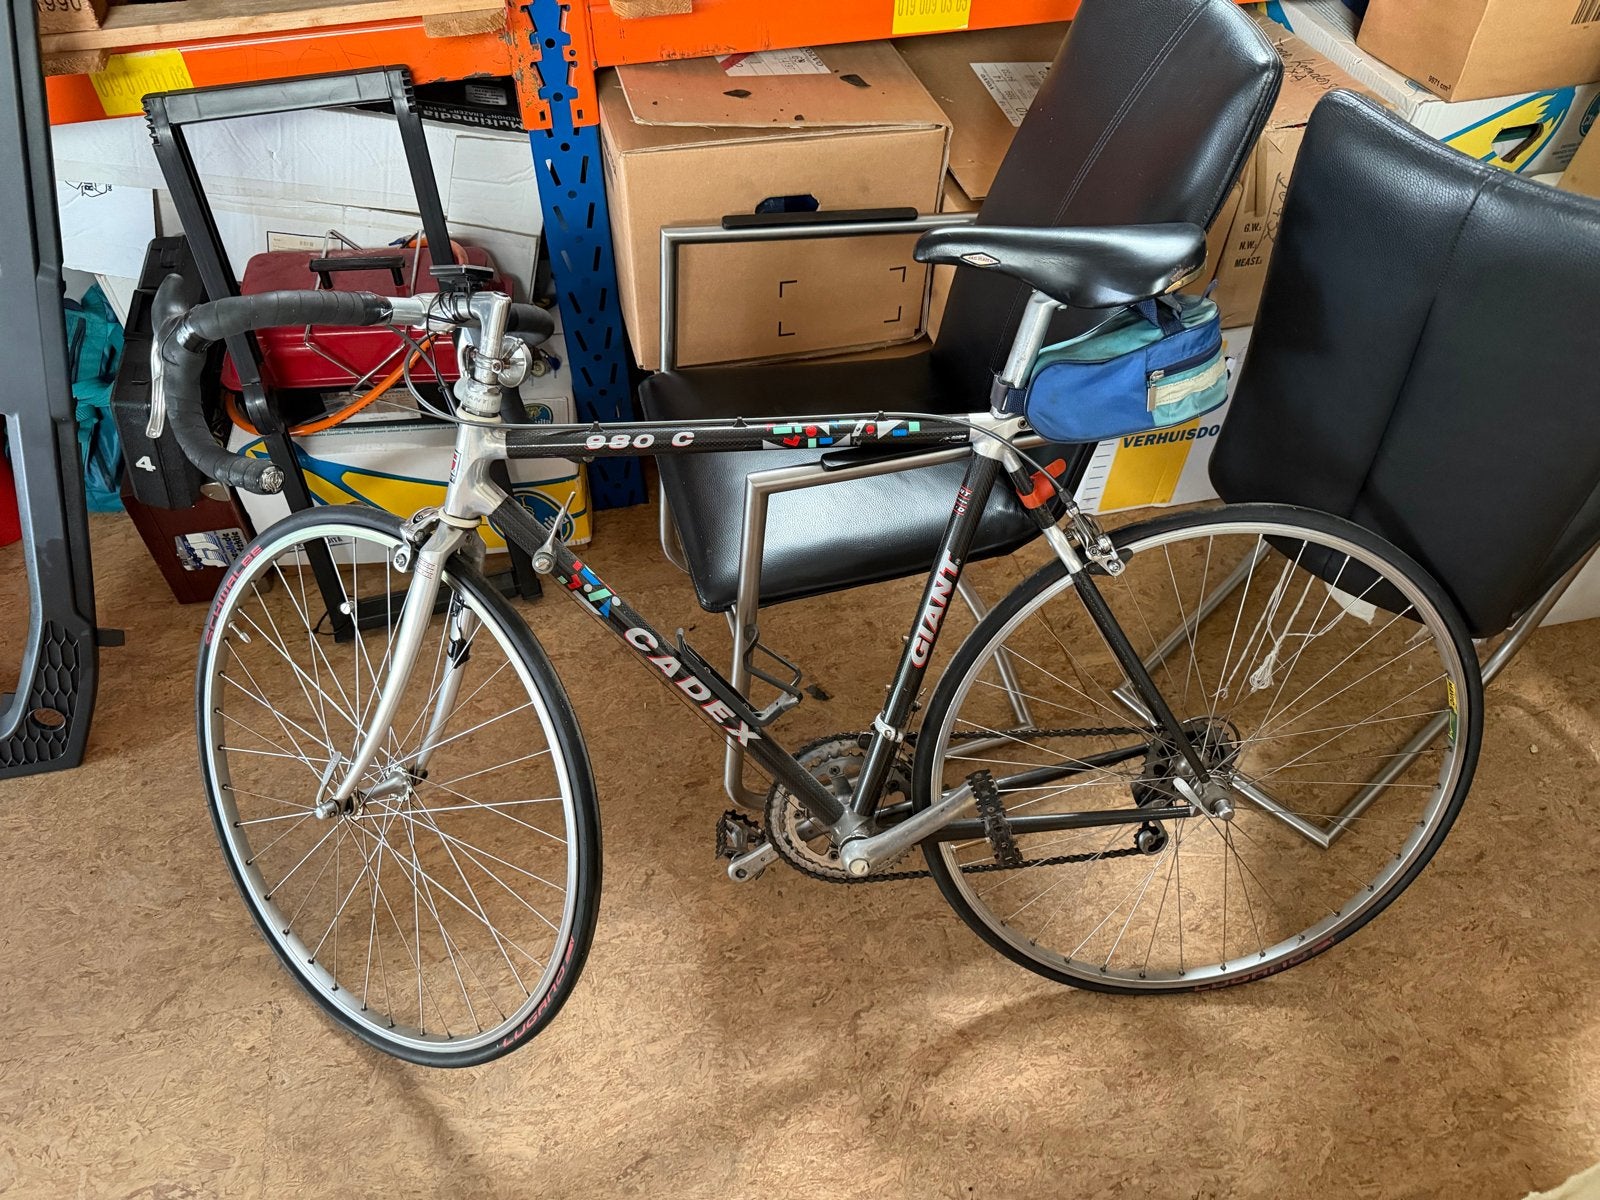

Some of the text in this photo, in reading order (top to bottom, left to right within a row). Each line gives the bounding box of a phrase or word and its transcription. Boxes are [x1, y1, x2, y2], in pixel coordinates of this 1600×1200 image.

[423, 109, 524, 130] Multimedia
[584, 431, 695, 450] 980 C
[1123, 424, 1220, 449] VERHUISDO
[135, 455, 157, 472] 4
[205, 545, 263, 645] SCHWALBE
[624, 627, 763, 748] CADEX
[502, 965, 566, 1048] LUGANO
